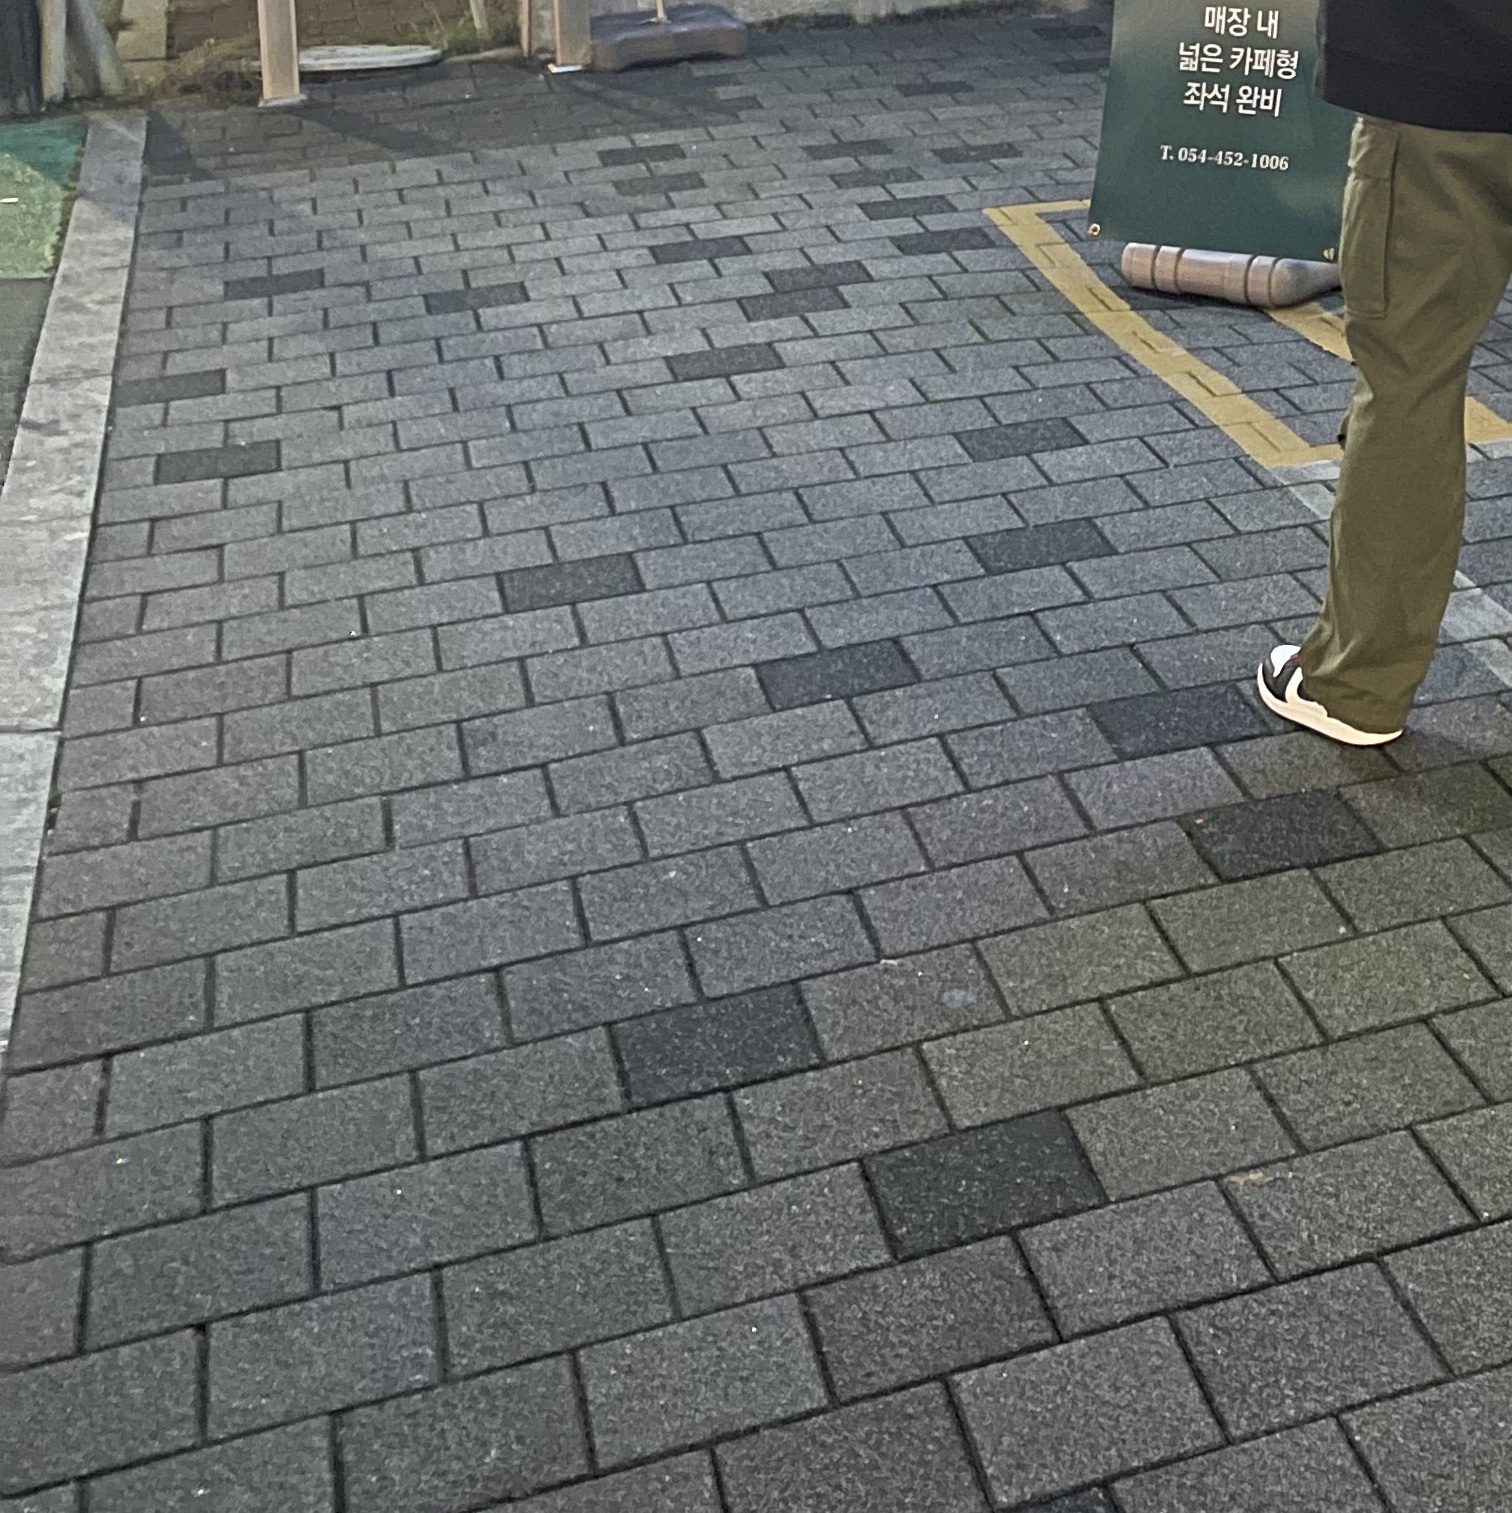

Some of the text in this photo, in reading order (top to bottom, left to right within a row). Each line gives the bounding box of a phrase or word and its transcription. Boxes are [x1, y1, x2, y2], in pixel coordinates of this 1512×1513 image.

[1204, 6, 1279, 39] 매장 내
[1178, 42, 1299, 79] 넓은 카페형
[1183, 82, 1282, 117] 좌석 완비
[1160, 145, 1289, 171] T. 054-452-1006
